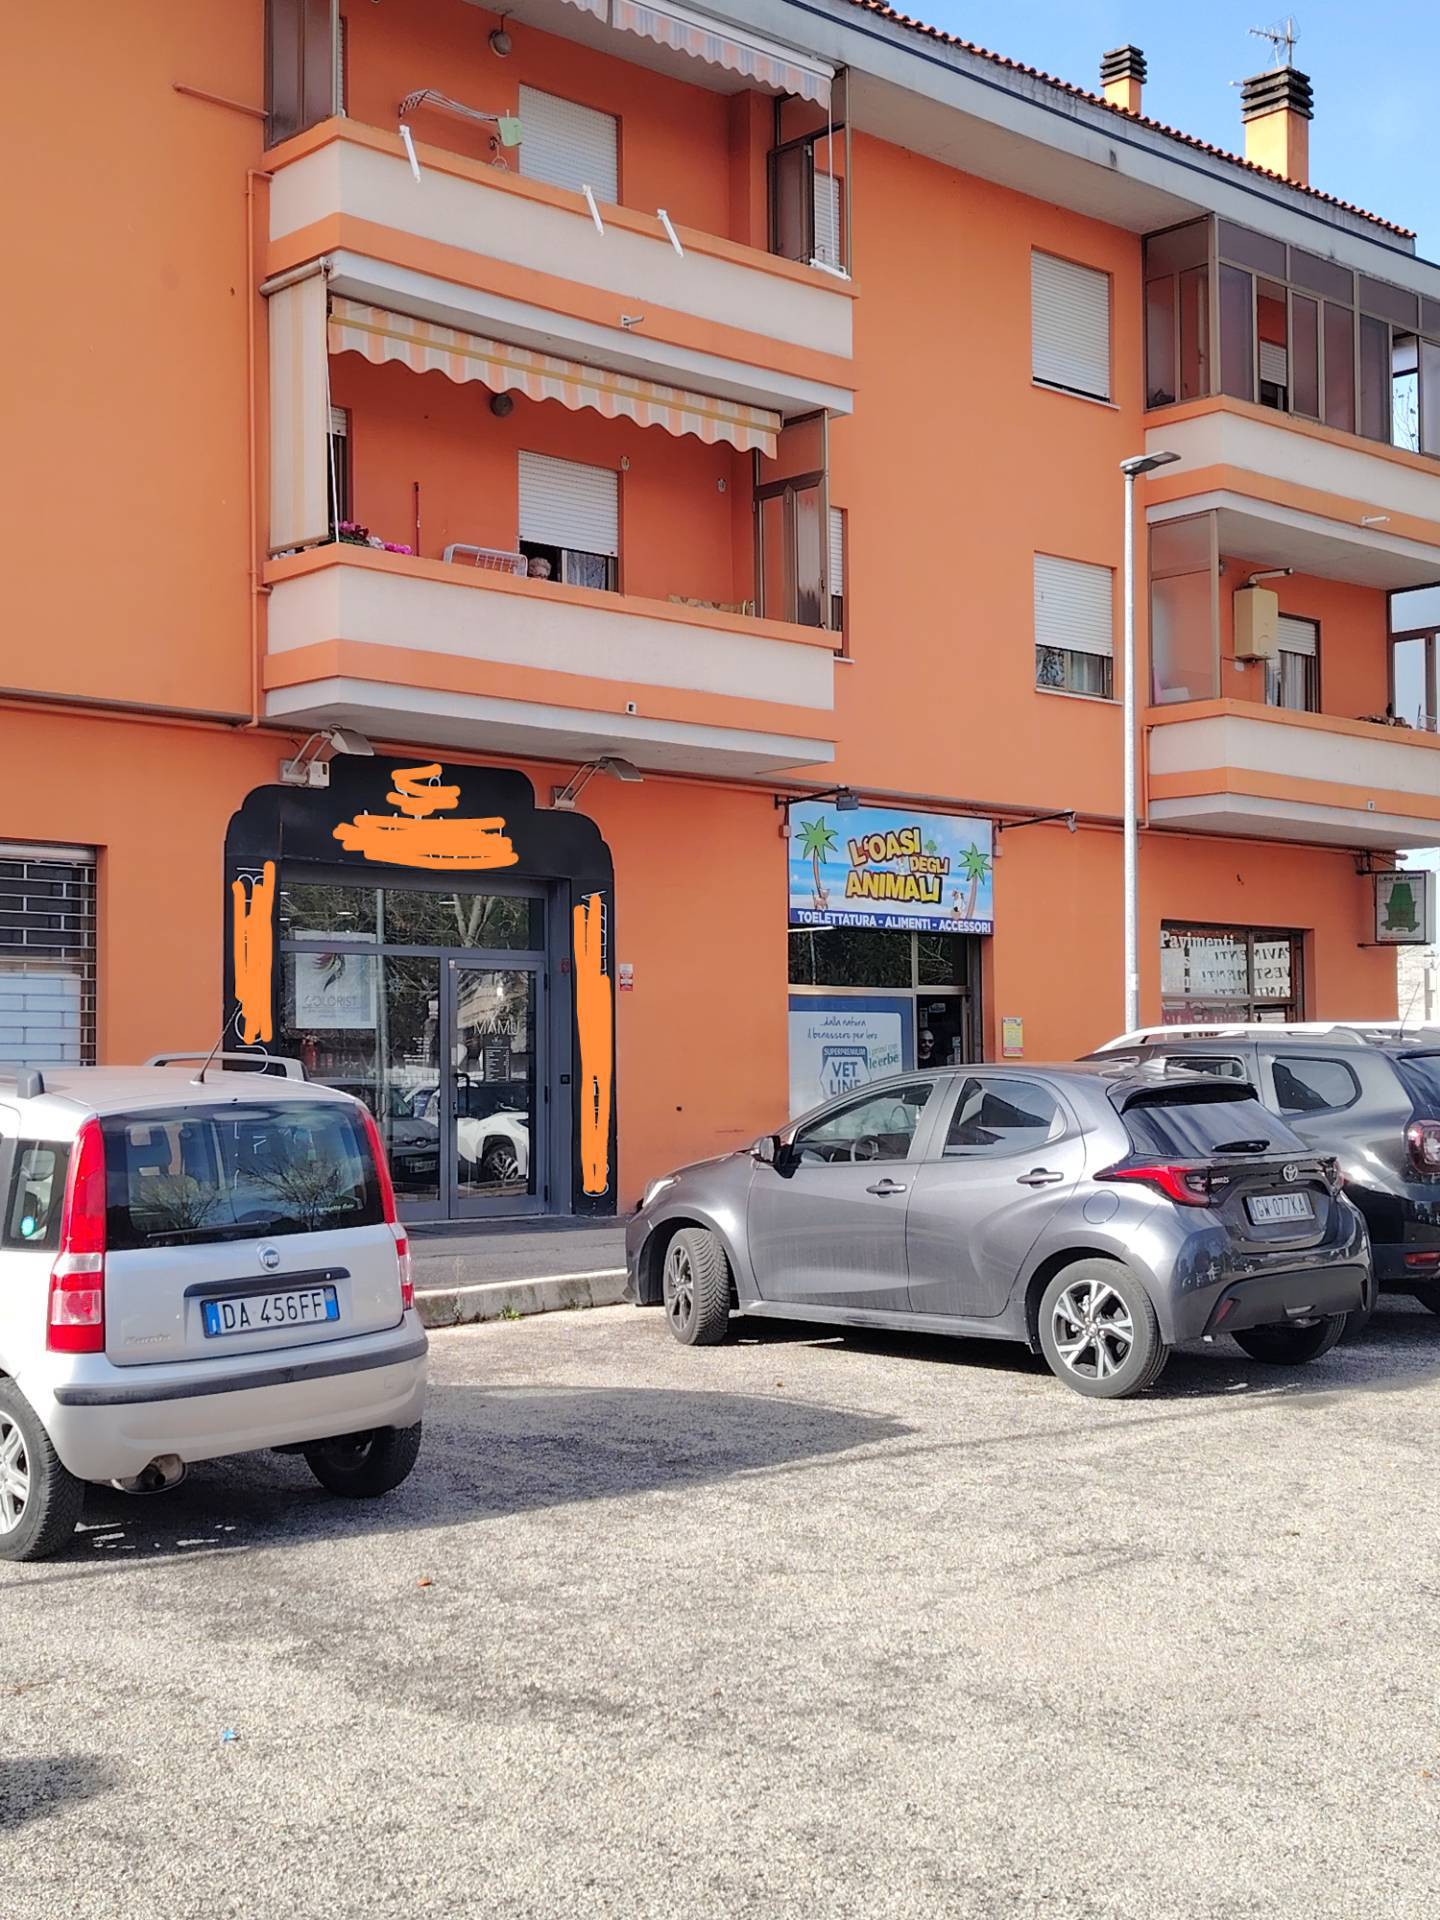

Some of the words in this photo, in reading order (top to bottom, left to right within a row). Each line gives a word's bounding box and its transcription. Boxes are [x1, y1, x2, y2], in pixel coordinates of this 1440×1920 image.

[848, 827, 921, 867] L'OASI
[909, 856, 950, 875] DEGLI
[845, 870, 942, 904] ANIMALI
[797, 910, 877, 927] TOELETTATURA
[884, 915, 931, 929] ALIMENTI
[938, 919, 991, 934] ACCESSORI
[1160, 930, 1234, 948] Pavimenti
[831, 1061, 858, 1078] VET
[222, 1301, 251, 1329] DA
[260, 1292, 322, 1324] 456FF
